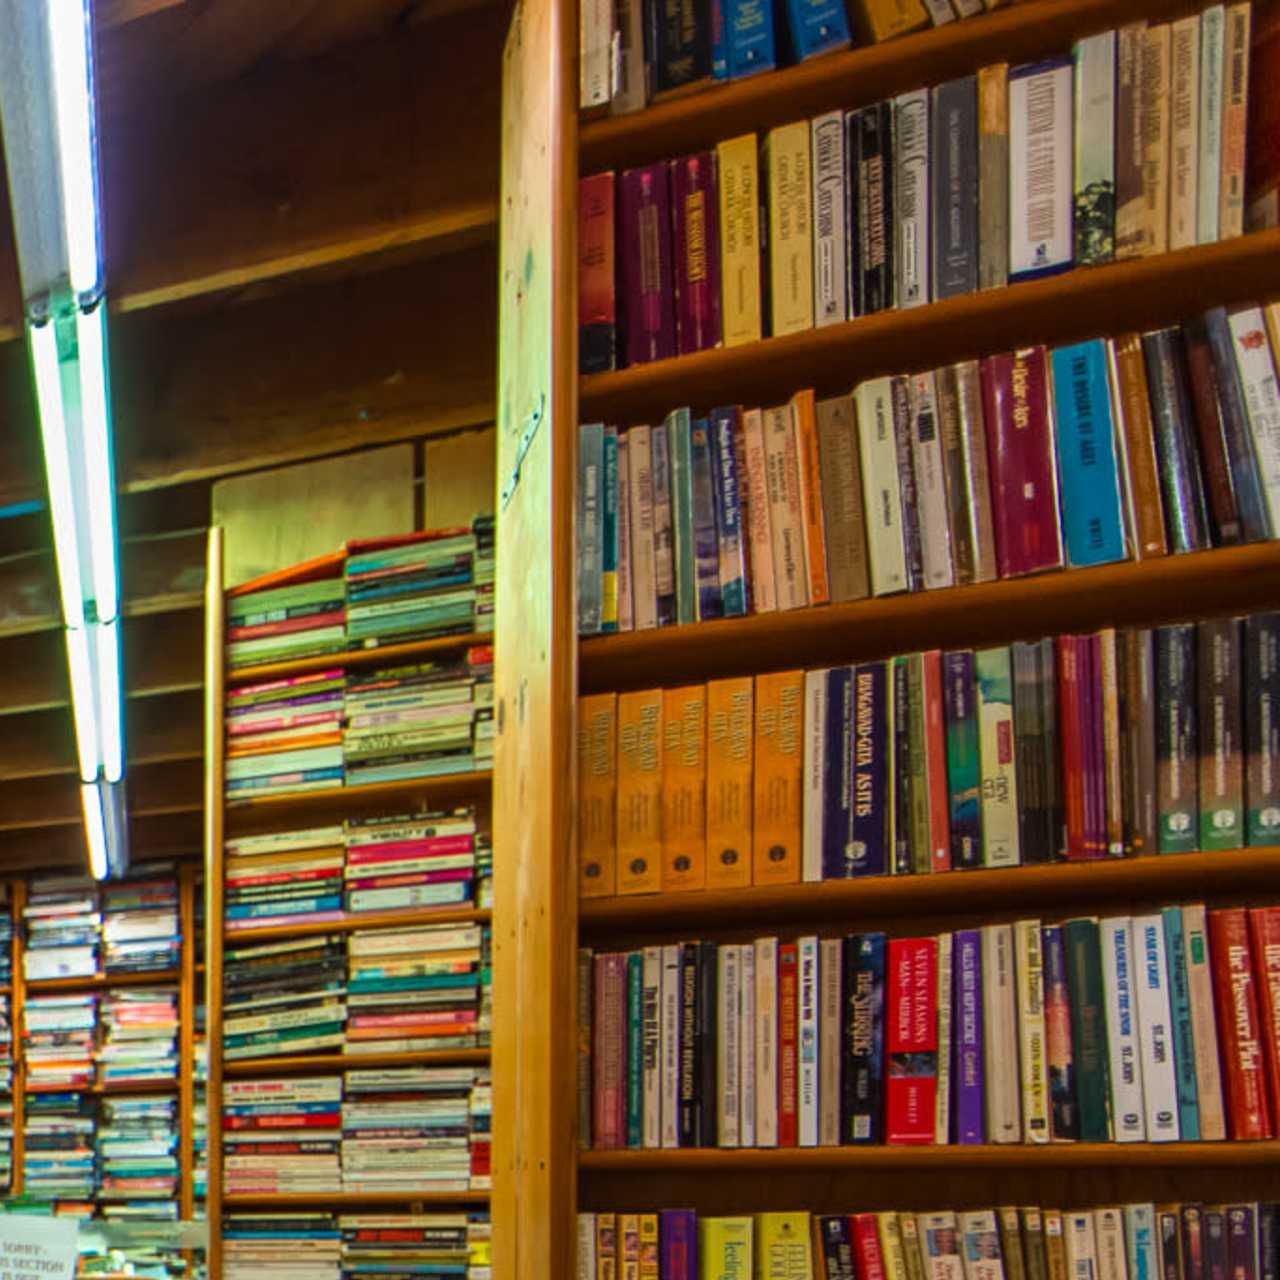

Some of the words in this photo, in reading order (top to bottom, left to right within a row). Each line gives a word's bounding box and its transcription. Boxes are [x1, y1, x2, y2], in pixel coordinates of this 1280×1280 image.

[856, 673, 873, 766] BHAGAVAD-GITA
[857, 773, 873, 789] AS
[858, 791, 873, 801] IT
[858, 803, 874, 816] IS
[914, 948, 928, 985] SEVEN
[1228, 945, 1246, 970] the
[857, 971, 871, 994] THE
[914, 990, 928, 1043] SEASONS
[1231, 972, 1253, 1036] Passover
[851, 994, 872, 1055] STIRRING
[1238, 1040, 1257, 1071] Plot
[2, 1242, 42, 1256] SORRY
[12, 1258, 65, 1273] SECTION
